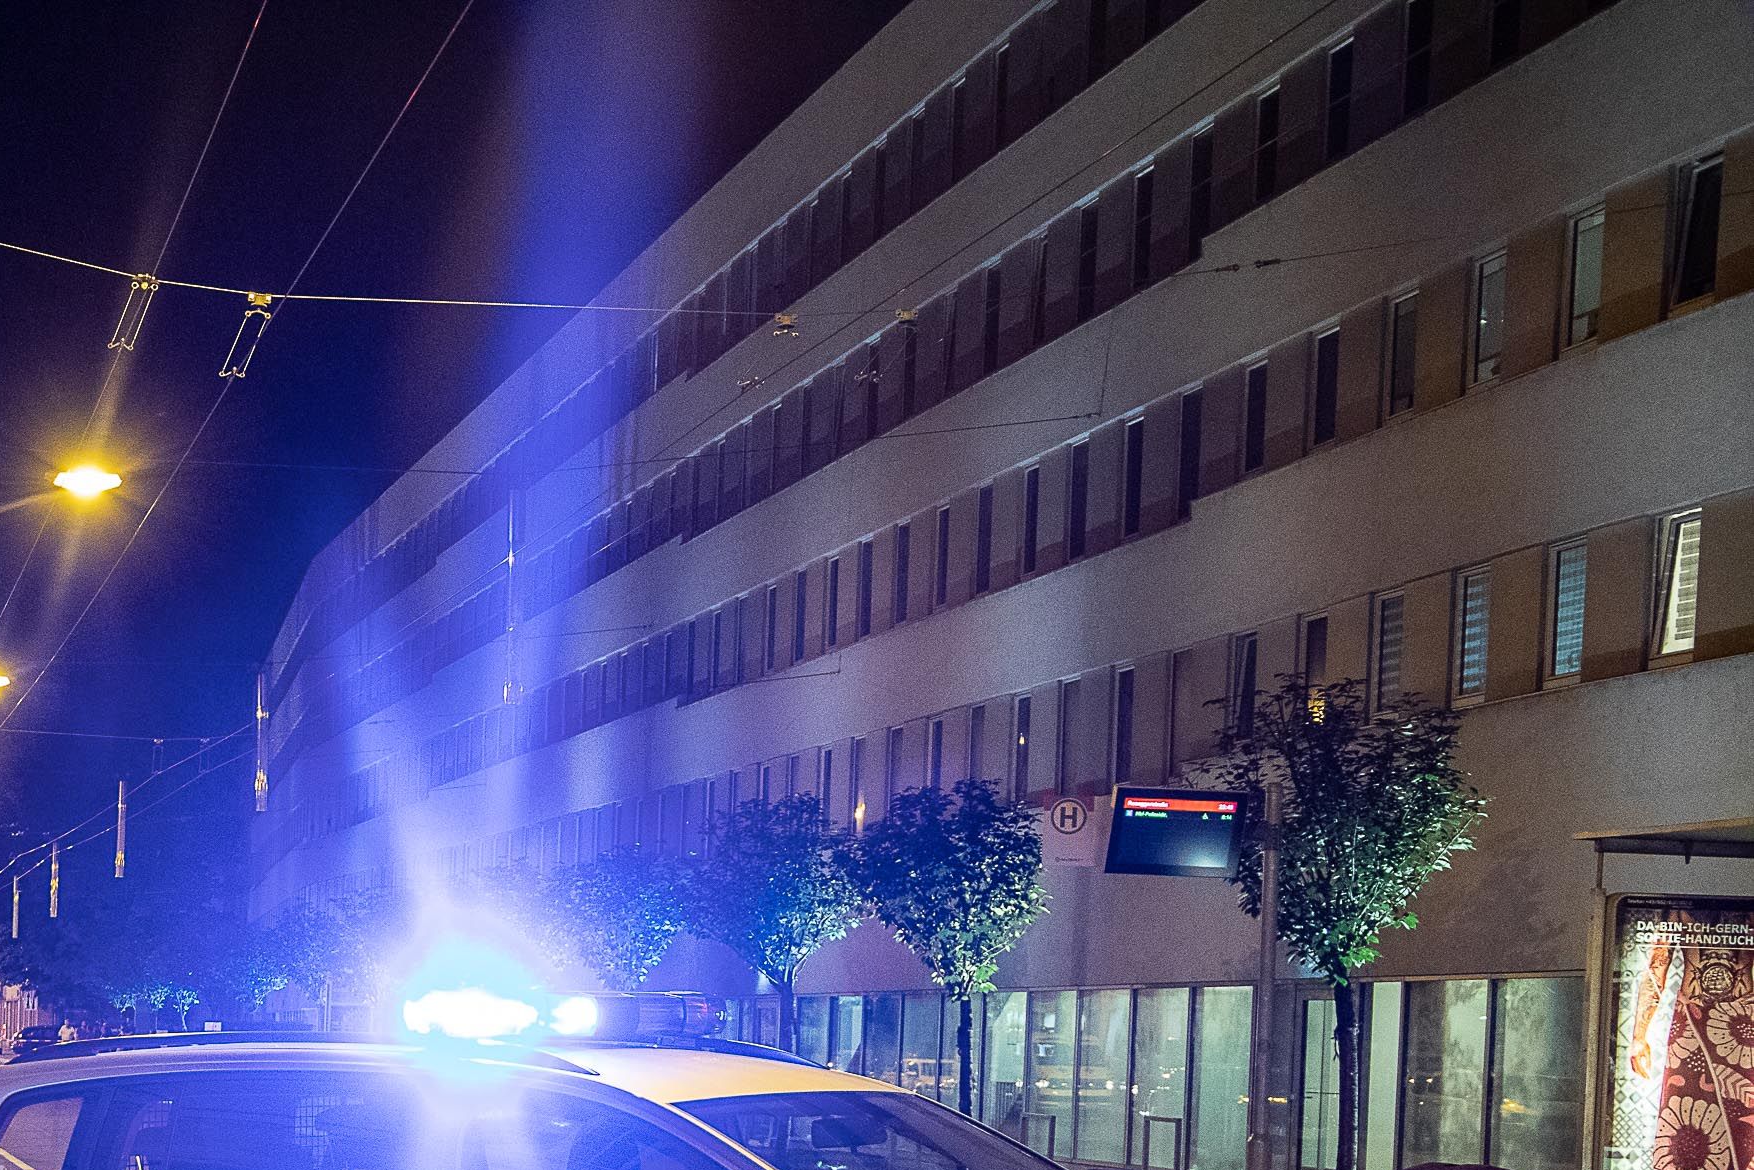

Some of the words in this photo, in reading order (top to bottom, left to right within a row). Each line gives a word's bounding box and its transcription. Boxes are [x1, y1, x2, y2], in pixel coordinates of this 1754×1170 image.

[1060, 806, 1078, 828] H
[1636, 920, 1754, 934] DA-BIN-ICH-GERN-
[1635, 931, 1754, 946] SOFTIE-HANDTUCH
